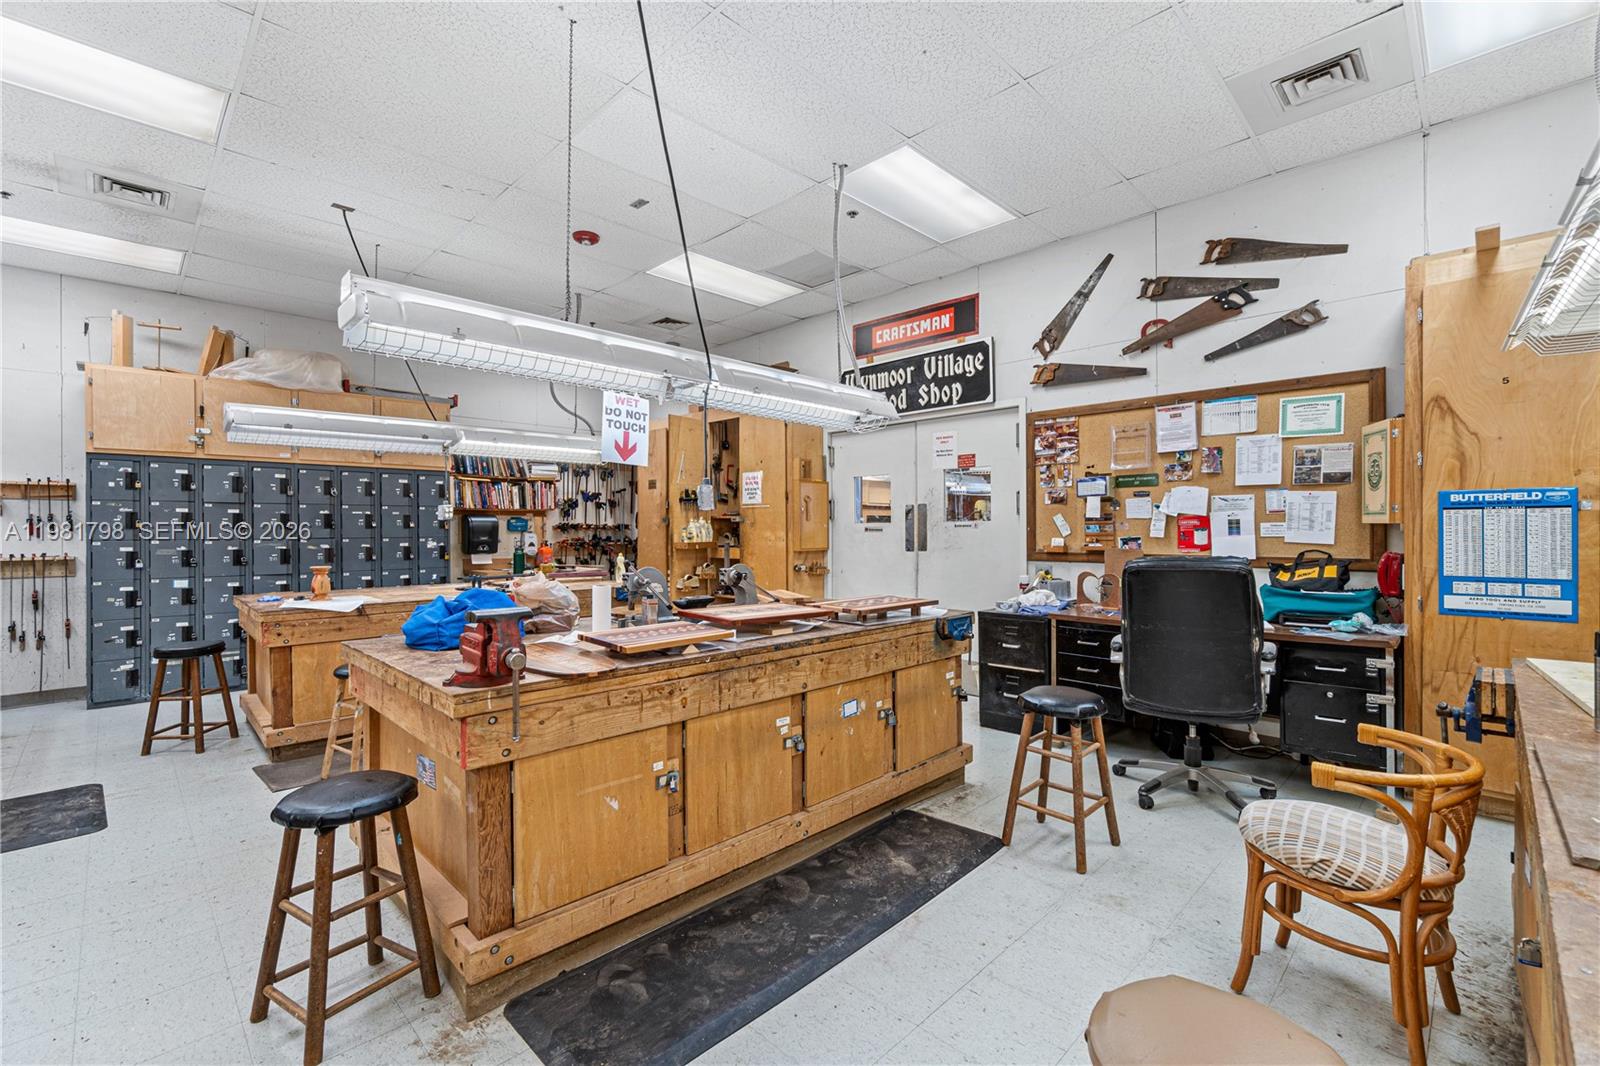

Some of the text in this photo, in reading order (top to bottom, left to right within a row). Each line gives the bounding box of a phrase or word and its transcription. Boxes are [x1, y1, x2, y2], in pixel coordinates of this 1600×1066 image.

[875, 313, 951, 344] CRAFTSMAN
[924, 352, 984, 380] Village
[1502, 376, 1510, 385] 5
[615, 395, 640, 408] WET
[889, 382, 963, 410] od Shop
[605, 406, 648, 422] DO NOT
[606, 418, 646, 434] TOUCH
[1450, 491, 1542, 501] BUTTERFIELD
